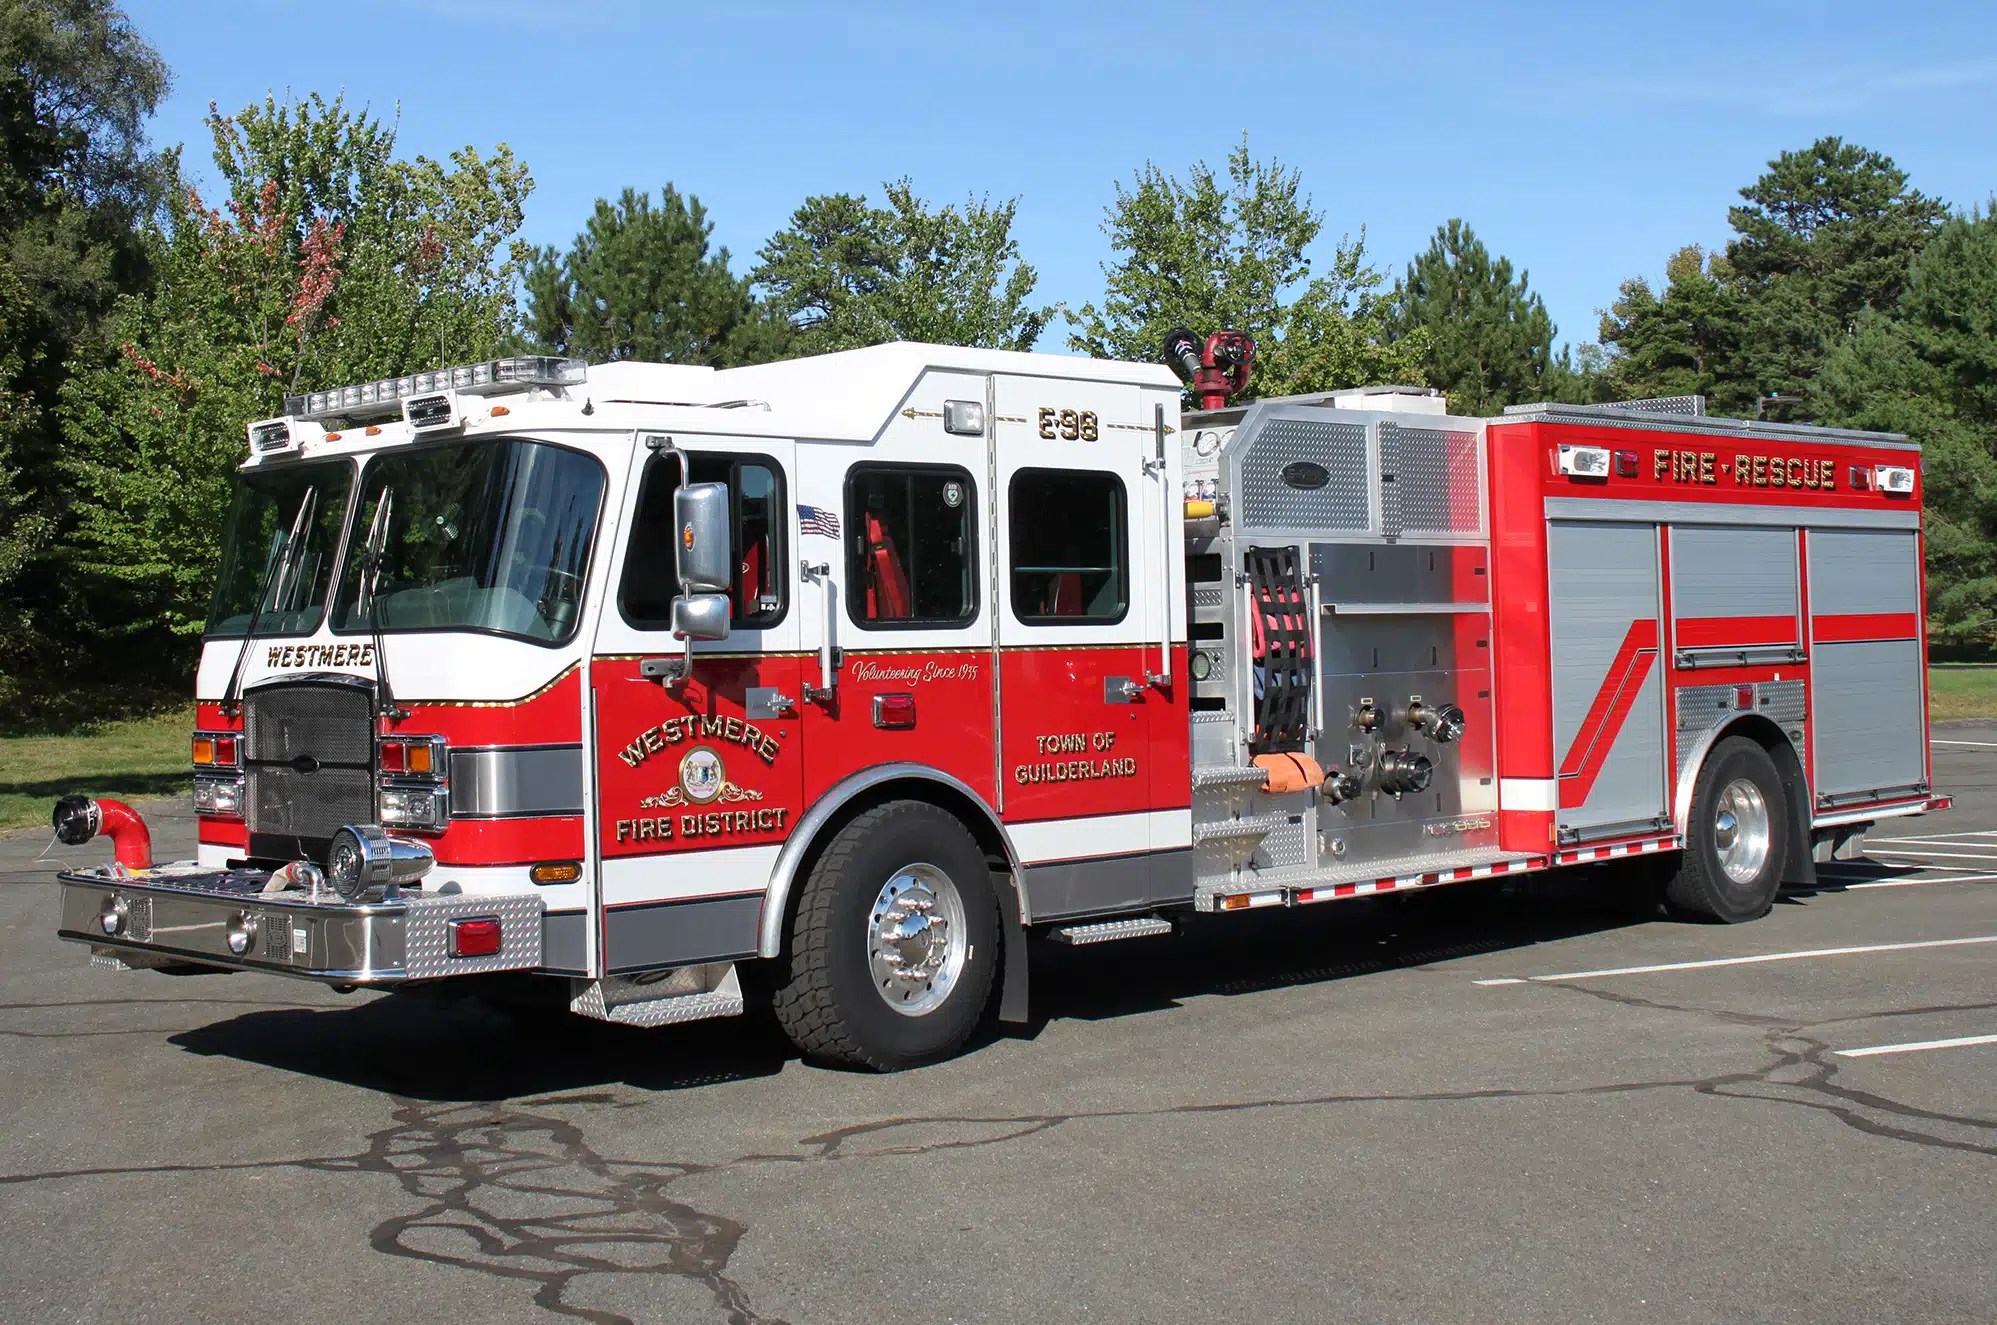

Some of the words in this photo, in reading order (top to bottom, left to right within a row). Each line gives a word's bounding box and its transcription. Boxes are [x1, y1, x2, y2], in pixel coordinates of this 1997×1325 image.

[1654, 449, 1716, 483] FIRE
[1735, 454, 1836, 489] RESCUE
[267, 643, 375, 667] WESTMERE
[852, 661, 922, 687] Volunteering
[923, 661, 955, 682] Since
[618, 714, 780, 768] WESTMERE
[1036, 733, 1087, 754] TOWN
[1092, 731, 1115, 751] OF
[1015, 757, 1136, 784] GUILDERLAND
[616, 816, 673, 842] FIRE
[681, 807, 787, 836] DISTRICT
